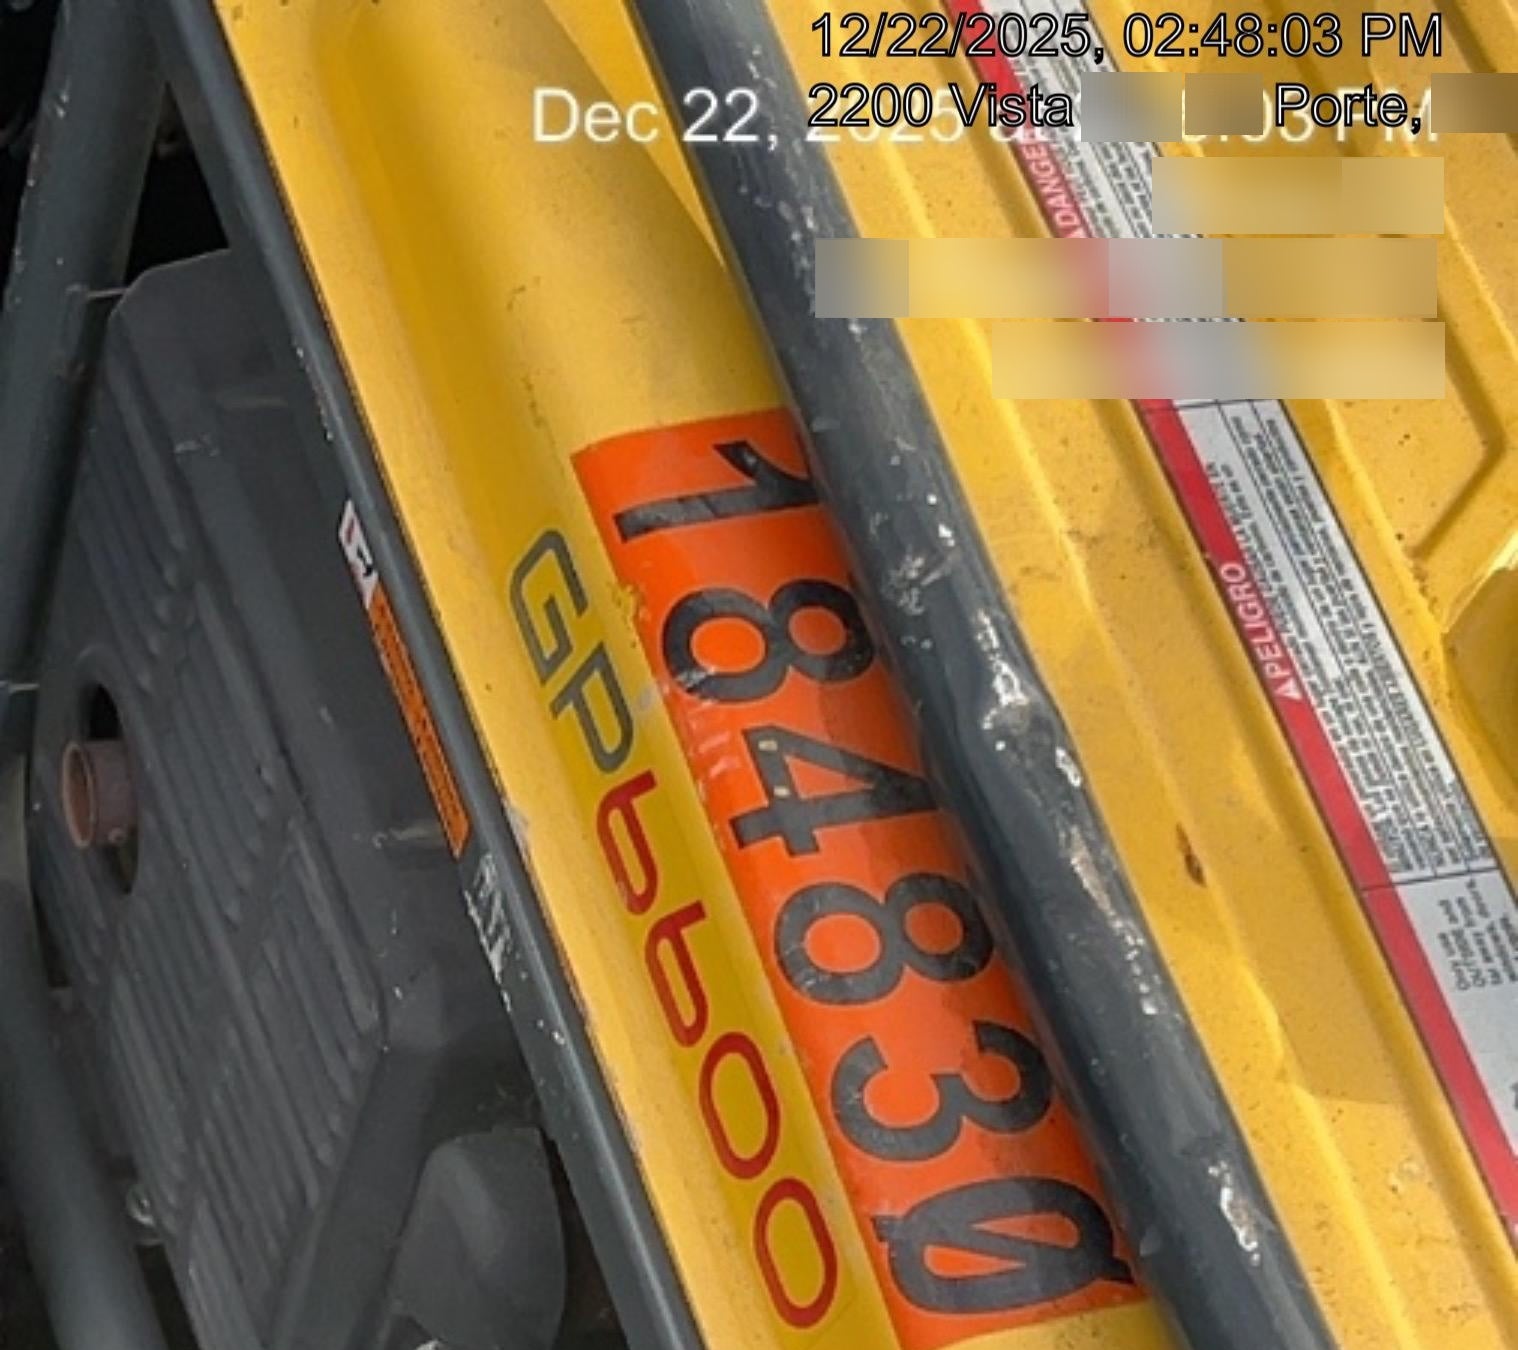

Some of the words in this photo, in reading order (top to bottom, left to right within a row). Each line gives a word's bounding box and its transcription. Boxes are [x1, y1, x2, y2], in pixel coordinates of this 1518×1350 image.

[1016, 126, 1082, 230] DANGE
[1219, 562, 1291, 678] PELIGRO
[508, 529, 839, 1330] GP6600
